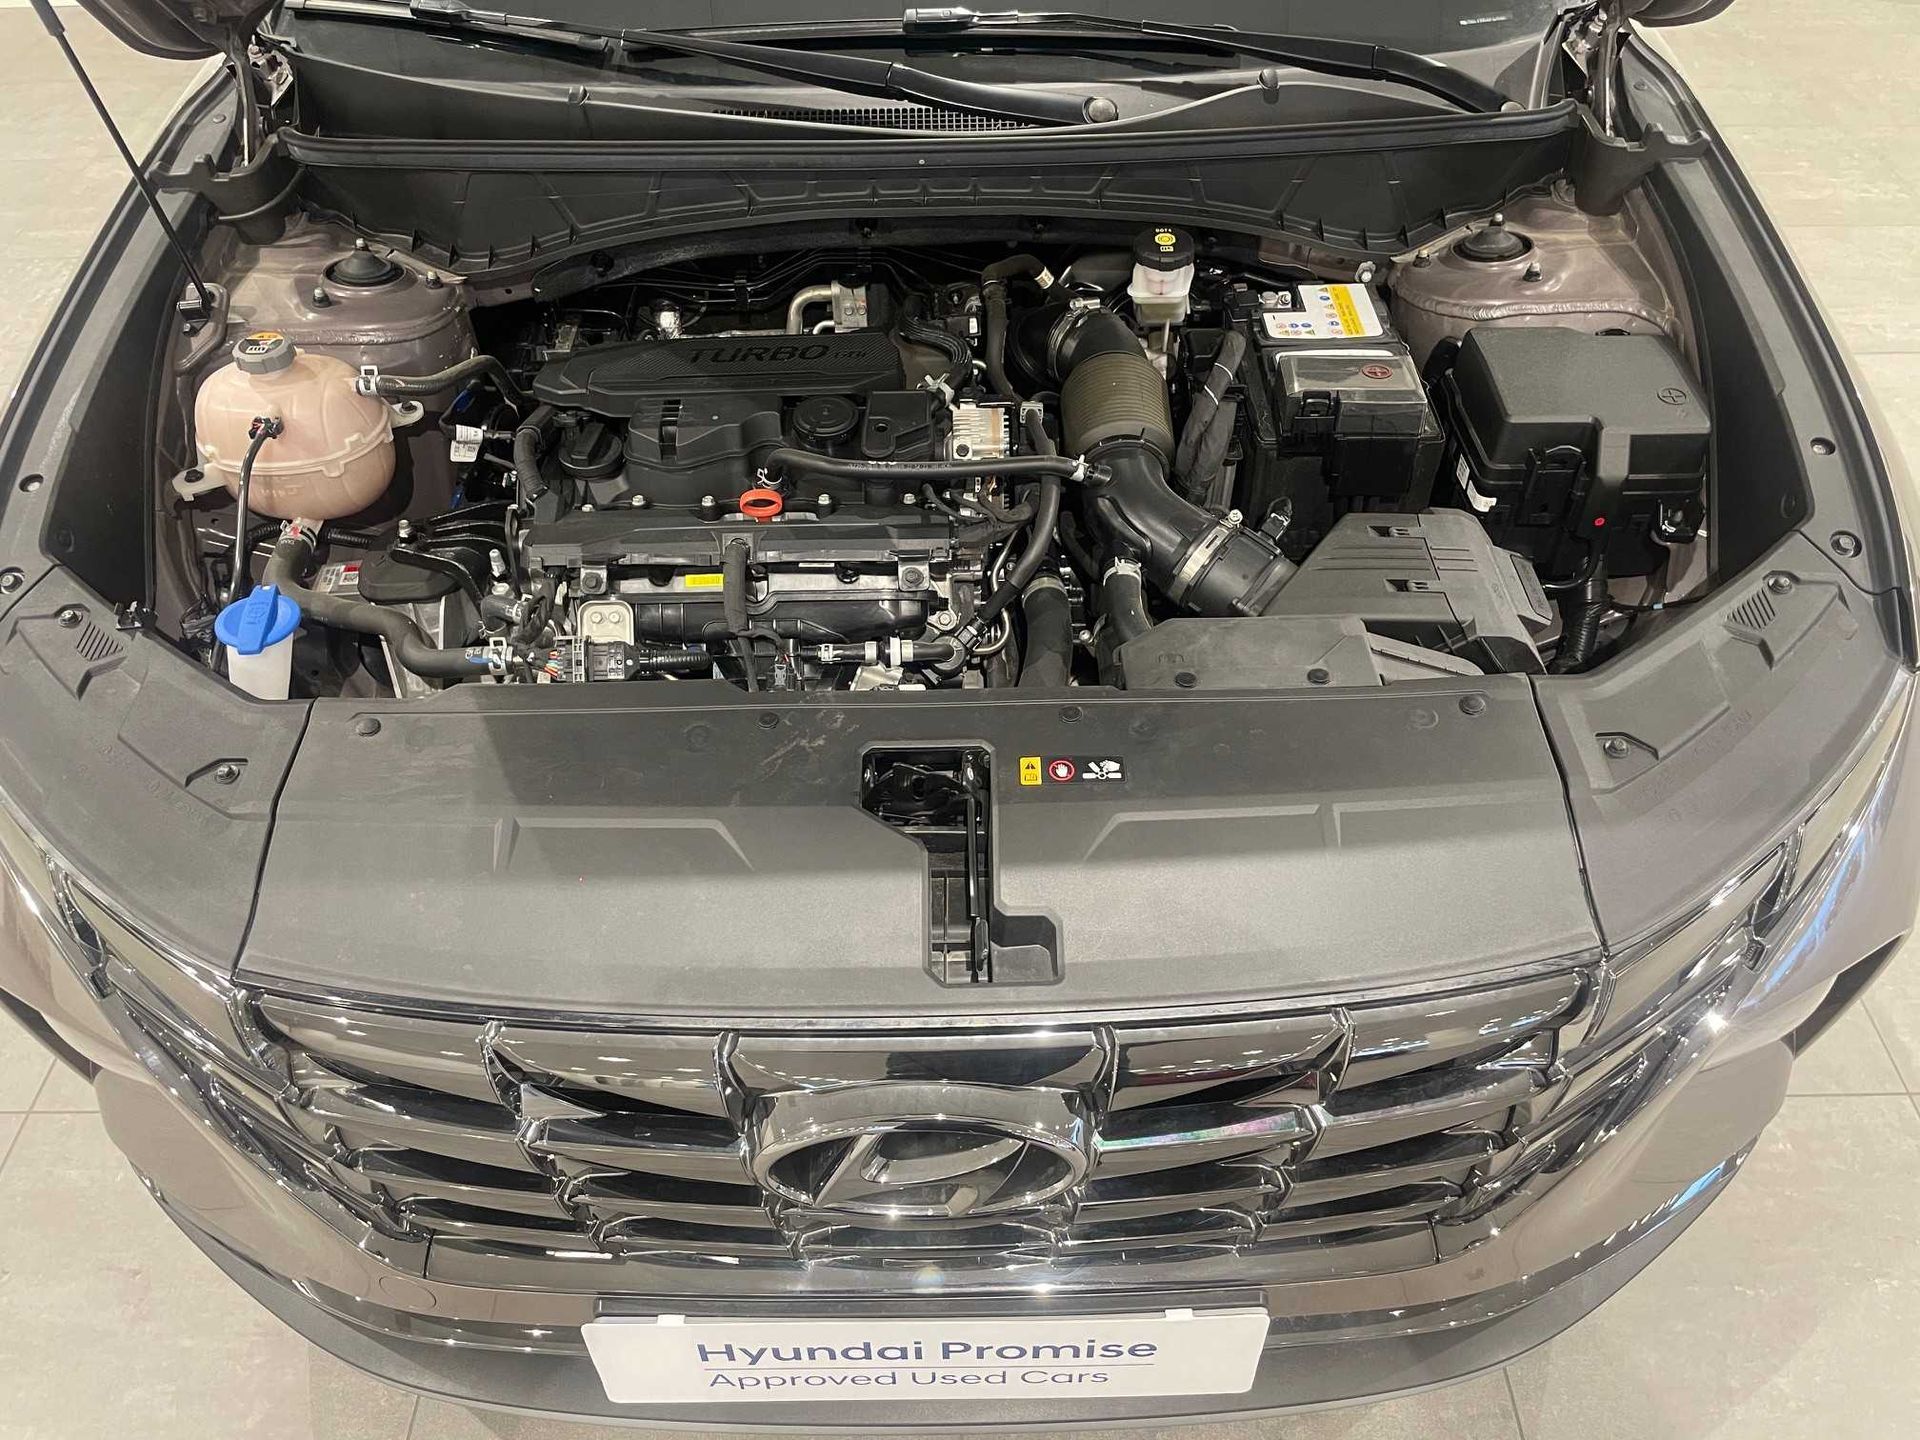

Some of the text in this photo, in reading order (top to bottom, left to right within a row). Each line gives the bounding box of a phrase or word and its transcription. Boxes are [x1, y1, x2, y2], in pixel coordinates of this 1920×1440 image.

[690, 344, 829, 363] TURBO
[697, 1340, 1158, 1366] Hyundai Promise
[709, 1370, 1109, 1390] Approved Used Cars
